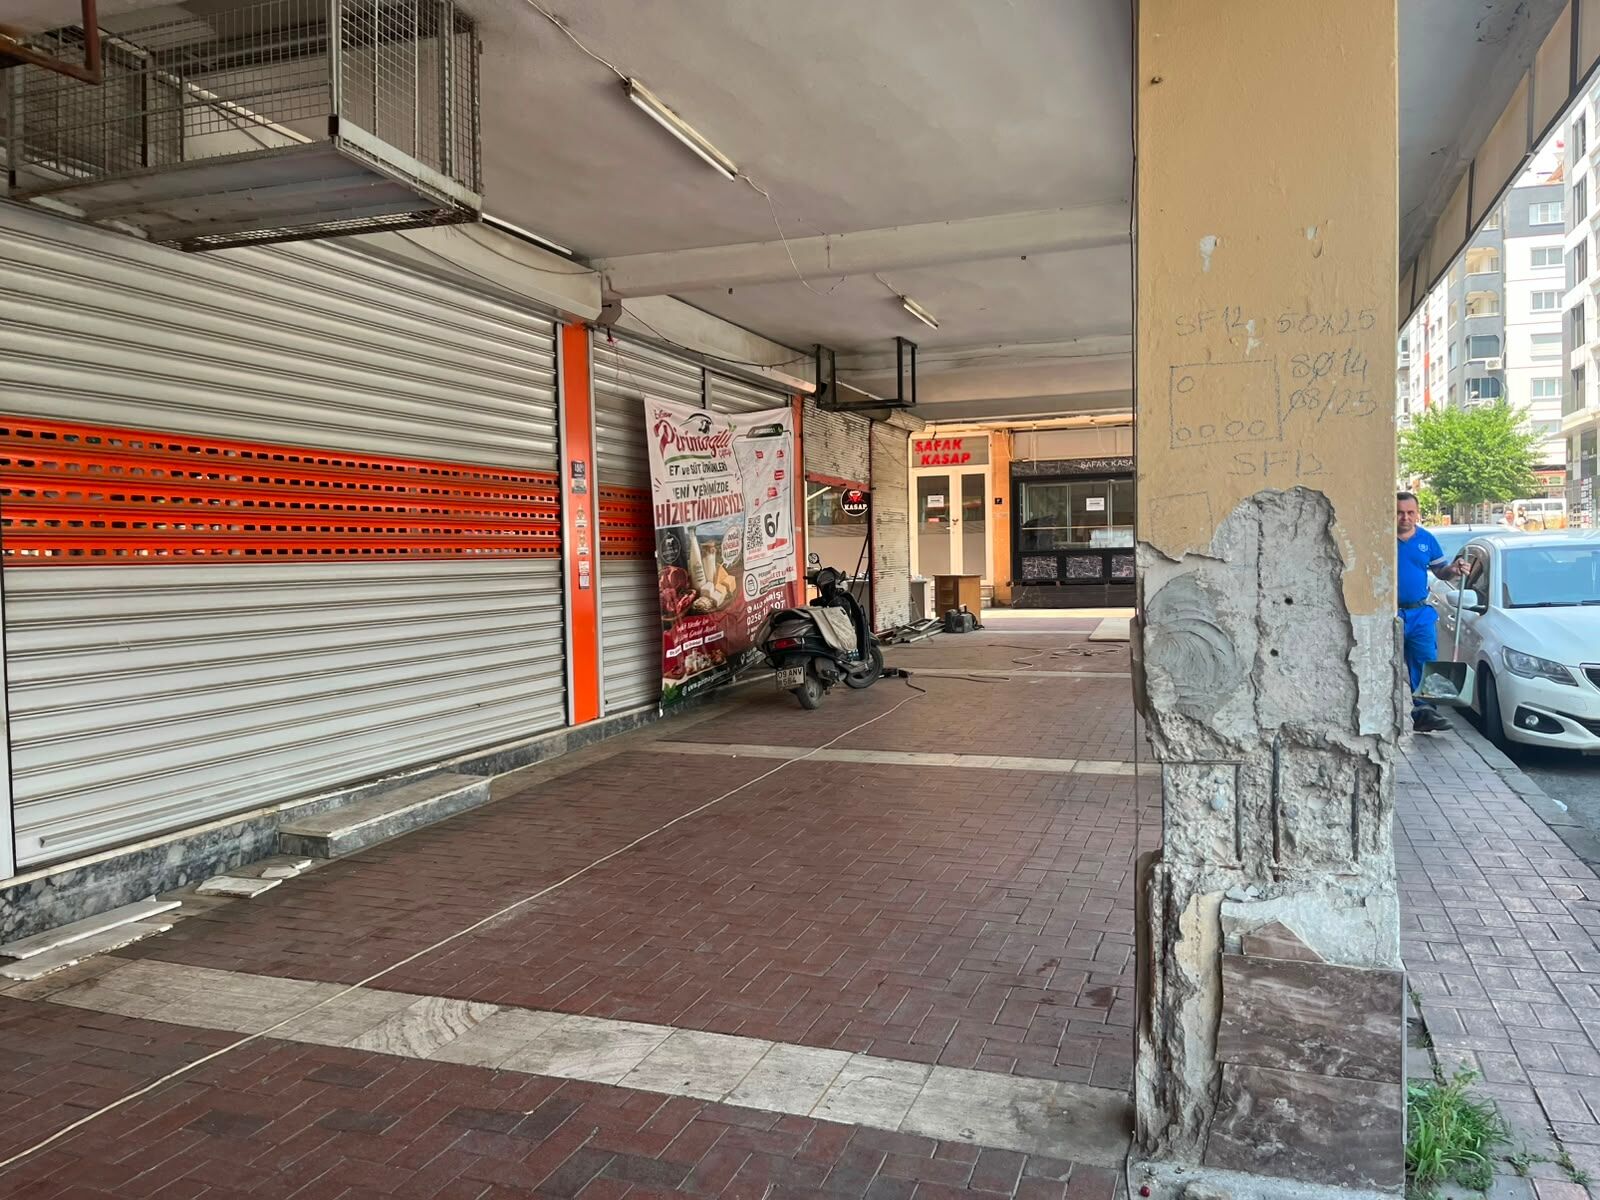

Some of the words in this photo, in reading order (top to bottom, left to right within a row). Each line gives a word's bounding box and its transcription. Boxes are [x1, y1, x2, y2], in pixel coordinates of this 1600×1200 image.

[921, 452, 971, 465] KASAP
[1110, 458, 1135, 467] KASA
[669, 464, 680, 476] ET
[681, 467, 690, 476] ve
[672, 484, 690, 499] ENİ
[844, 503, 868, 511] KASAP
[746, 611, 762, 626] 0256
[777, 671, 787, 679] 09
[788, 667, 803, 677] ANV
